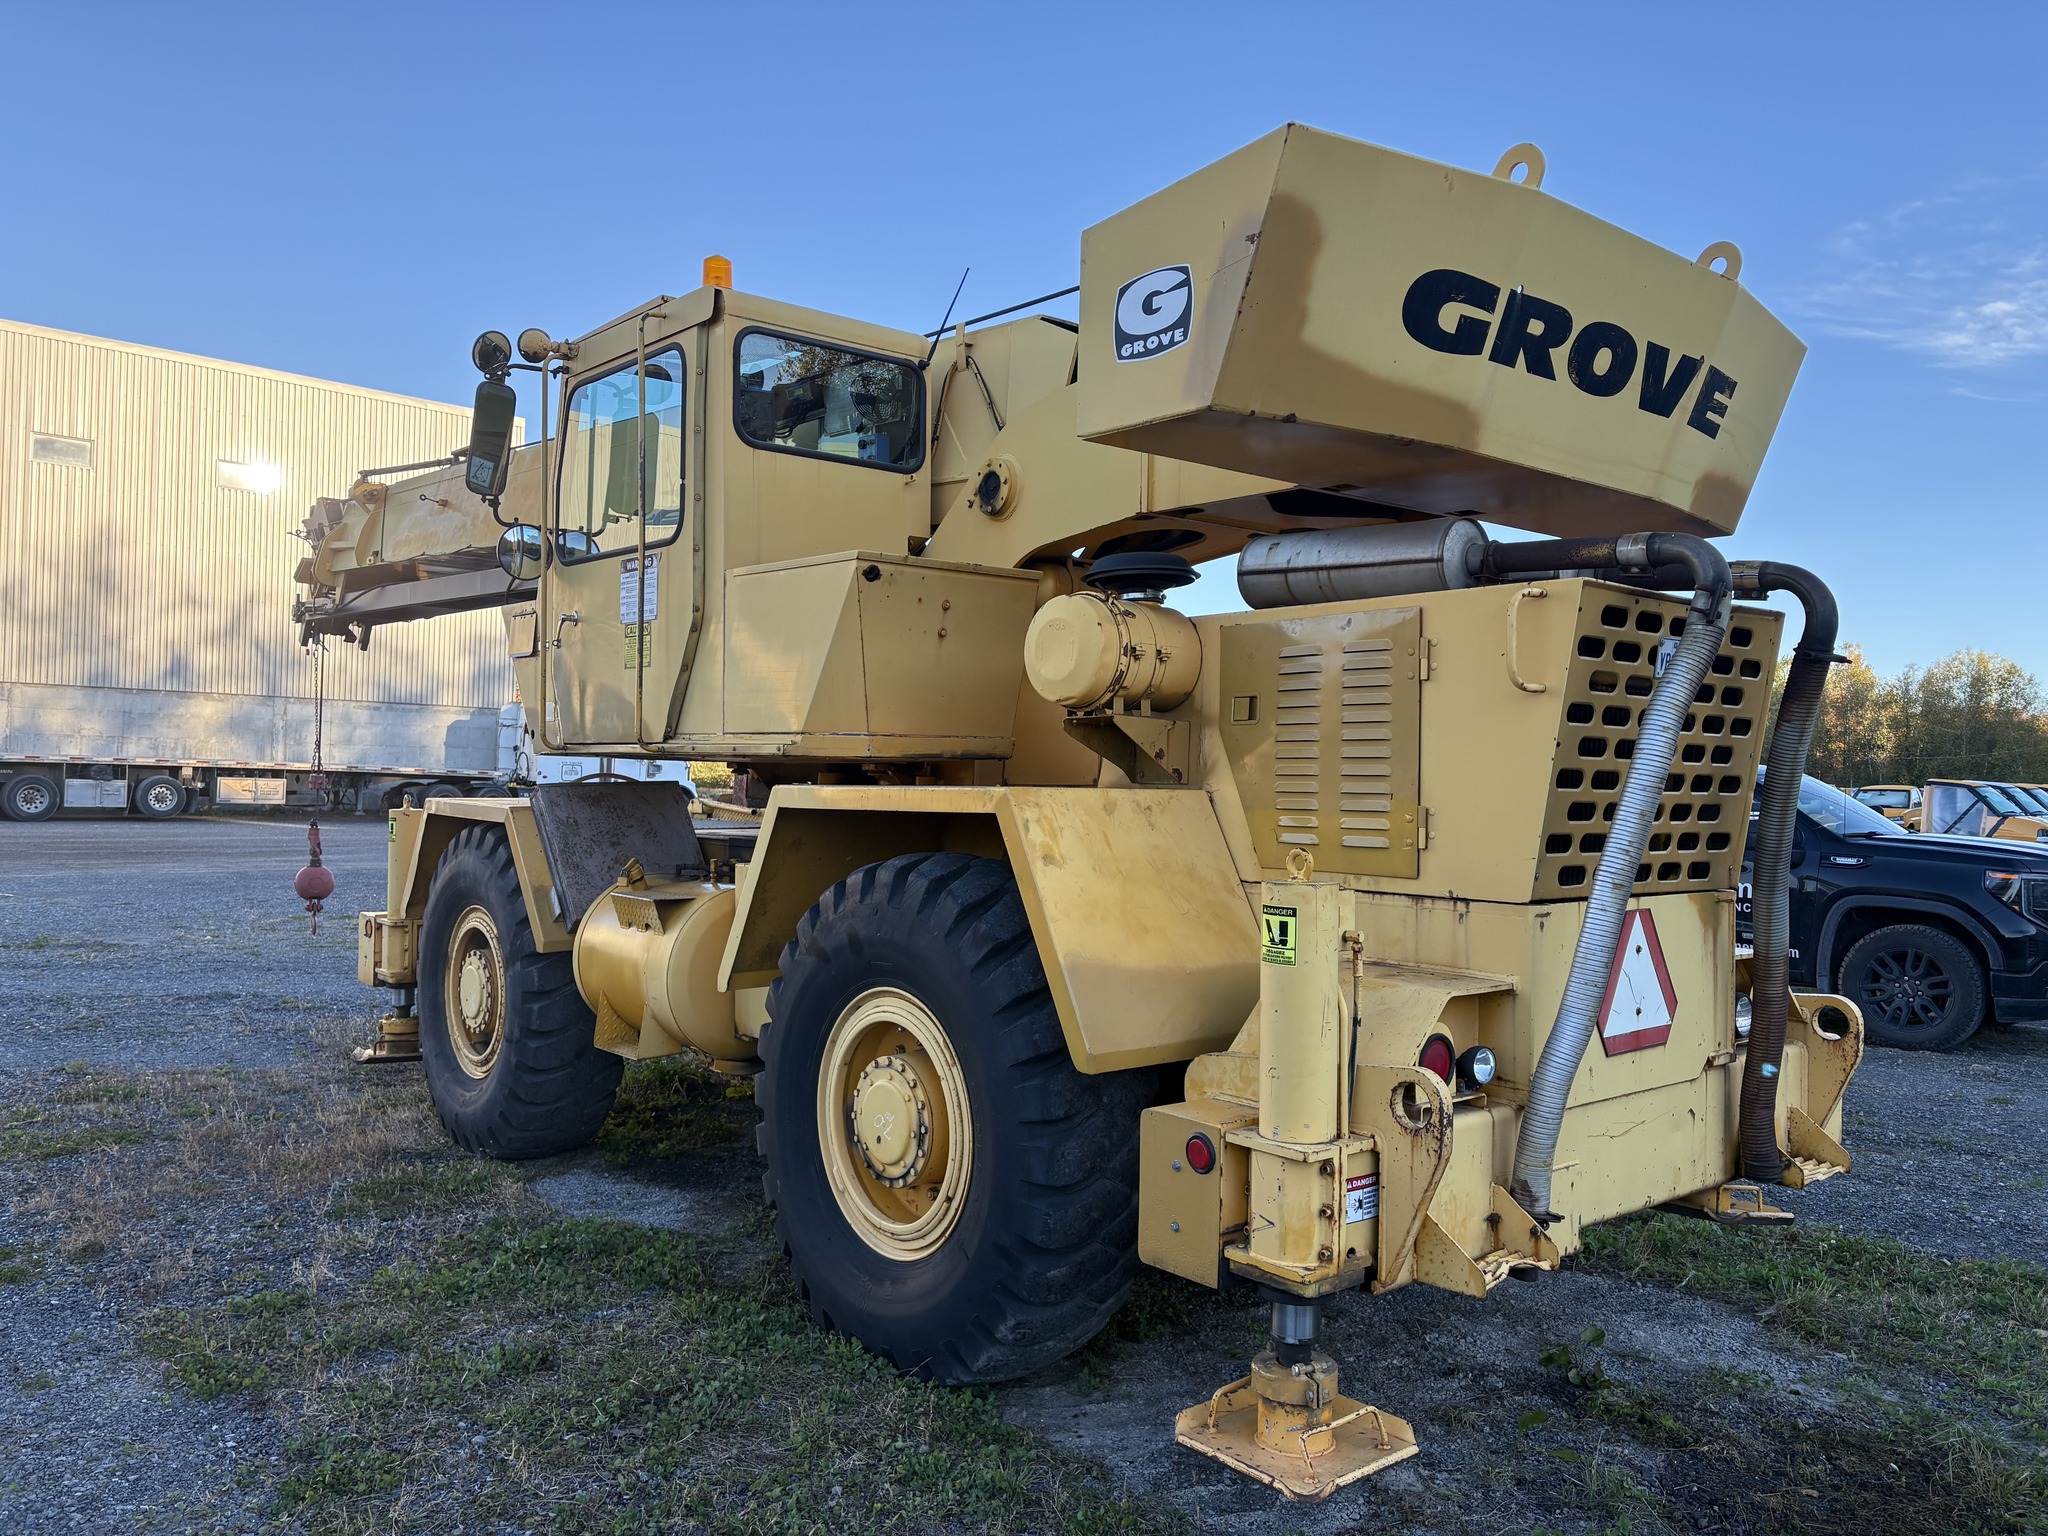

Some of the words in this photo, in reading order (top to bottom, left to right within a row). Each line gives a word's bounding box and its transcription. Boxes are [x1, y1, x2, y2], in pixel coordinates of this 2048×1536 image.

[1120, 328, 1184, 357] GROVE
[1401, 268, 1738, 440] GROVE
[626, 557, 653, 570] WARNG
[626, 624, 650, 635] CAUN
[1267, 907, 1293, 916] DANGER
[1352, 1175, 1377, 1188] DANGER
